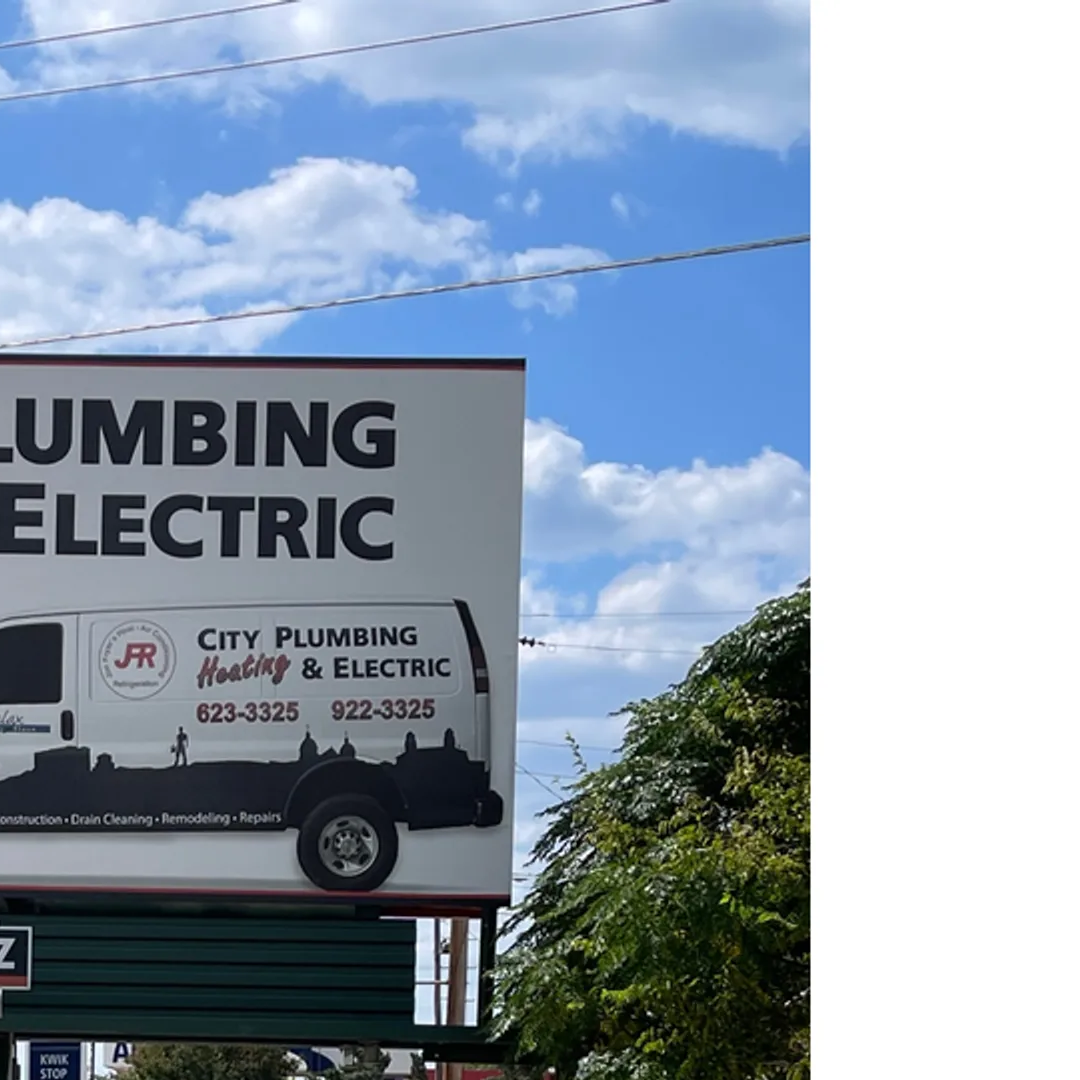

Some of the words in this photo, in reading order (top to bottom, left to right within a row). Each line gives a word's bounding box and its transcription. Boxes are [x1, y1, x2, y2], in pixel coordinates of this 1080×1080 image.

[197, 628, 261, 651] CITY
[275, 626, 418, 649] PLUMBING
[196, 652, 291, 689] Heating
[302, 658, 323, 679] &
[333, 657, 452, 679] ELECTRIC
[197, 702, 300, 724] 623-3325
[331, 699, 436, 721] 922-3325
[70, 813, 101, 825] Drain
[103, 812, 153, 828] Cleaning
[161, 811, 230, 826] Remodeling
[239, 810, 281, 825] Repairs
[39, 1053, 69, 1066] KWIK
[39, 1068, 68, 1080] STOP
